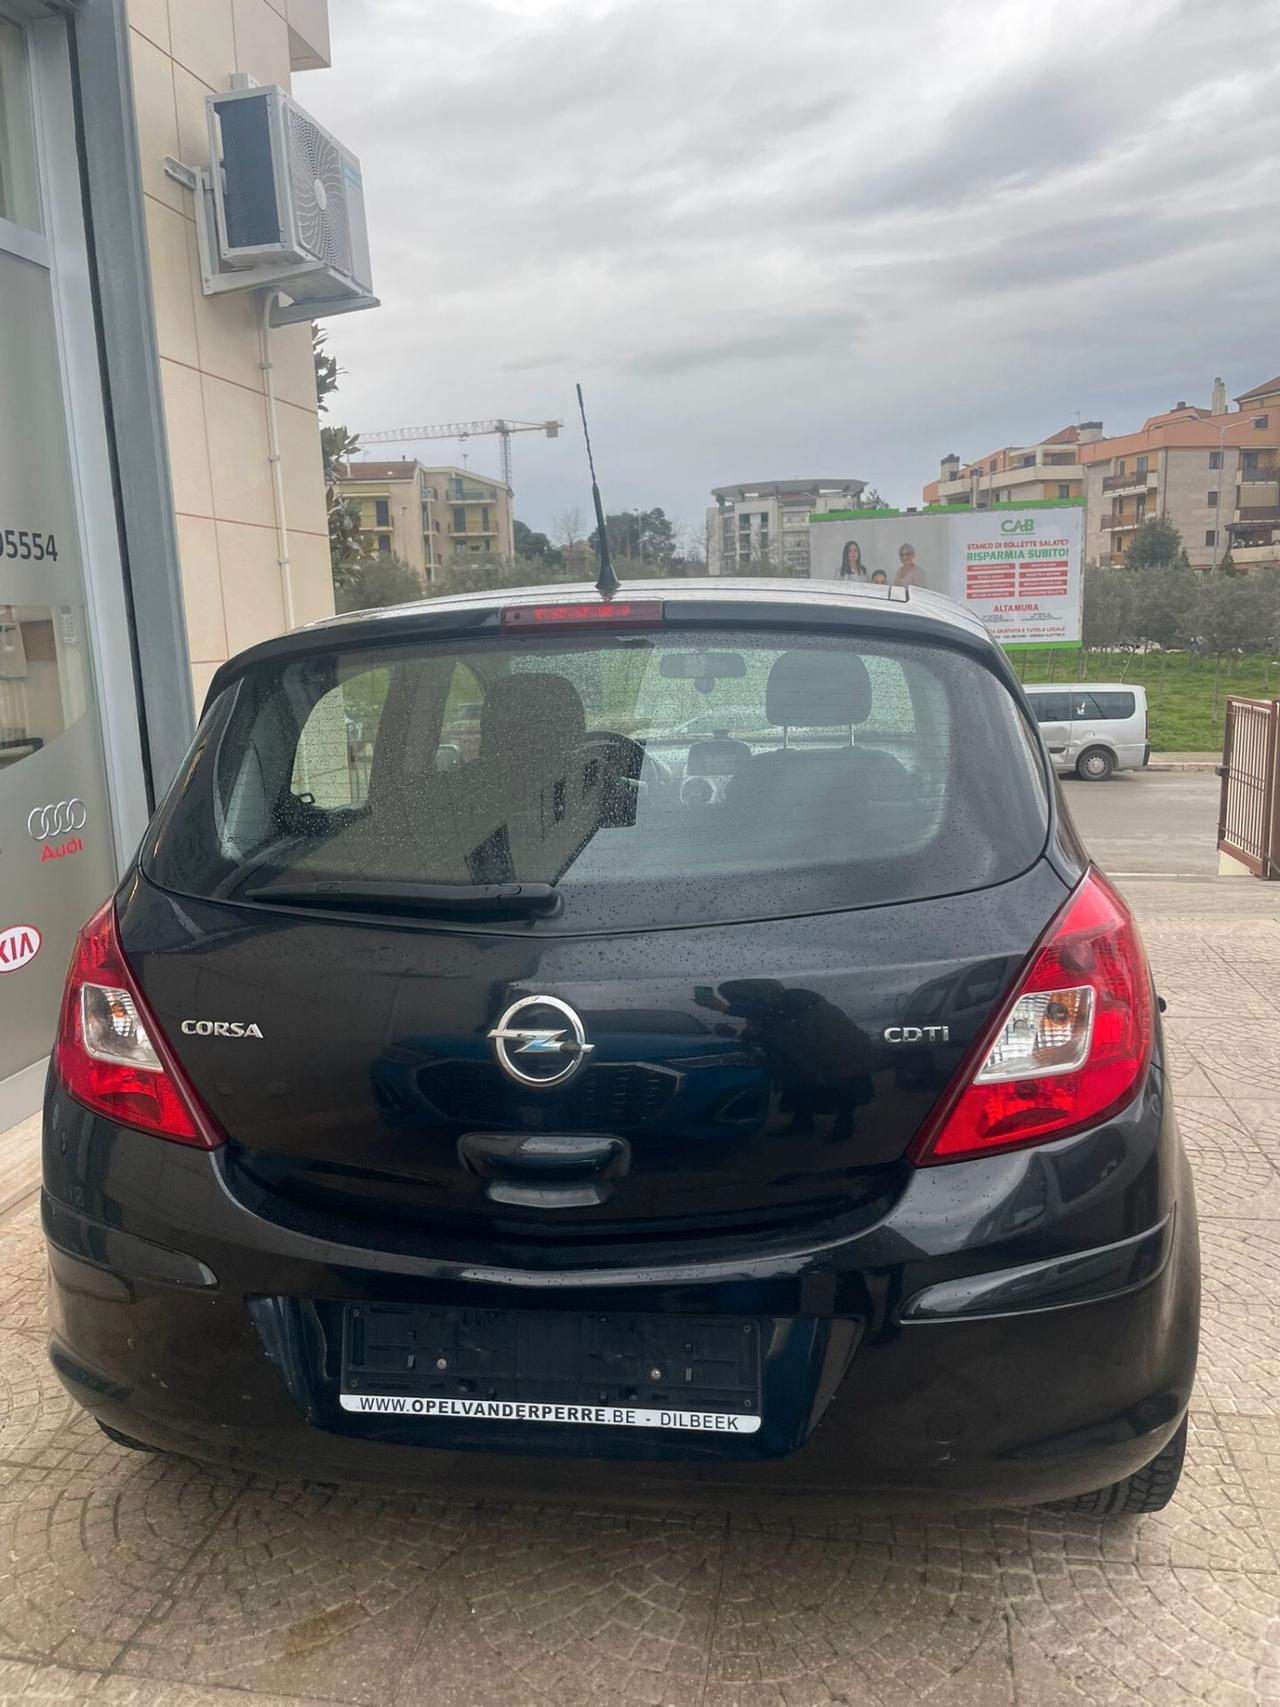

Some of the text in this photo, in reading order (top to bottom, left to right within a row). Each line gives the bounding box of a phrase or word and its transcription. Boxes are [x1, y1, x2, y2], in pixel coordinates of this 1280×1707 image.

[1001, 519, 1035, 532] CAB
[1039, 539, 1069, 547] SALATE?
[967, 548, 1069, 561] RISPARMIA SUBITO!
[993, 603, 1040, 612] ALTAMURA
[40, 838, 83, 863] Audi
[181, 1020, 264, 1039] CORSA
[360, 1397, 636, 1424] WWW.OPELVANDERPERRE.BE
[660, 1412, 739, 1430] DILBEEK
